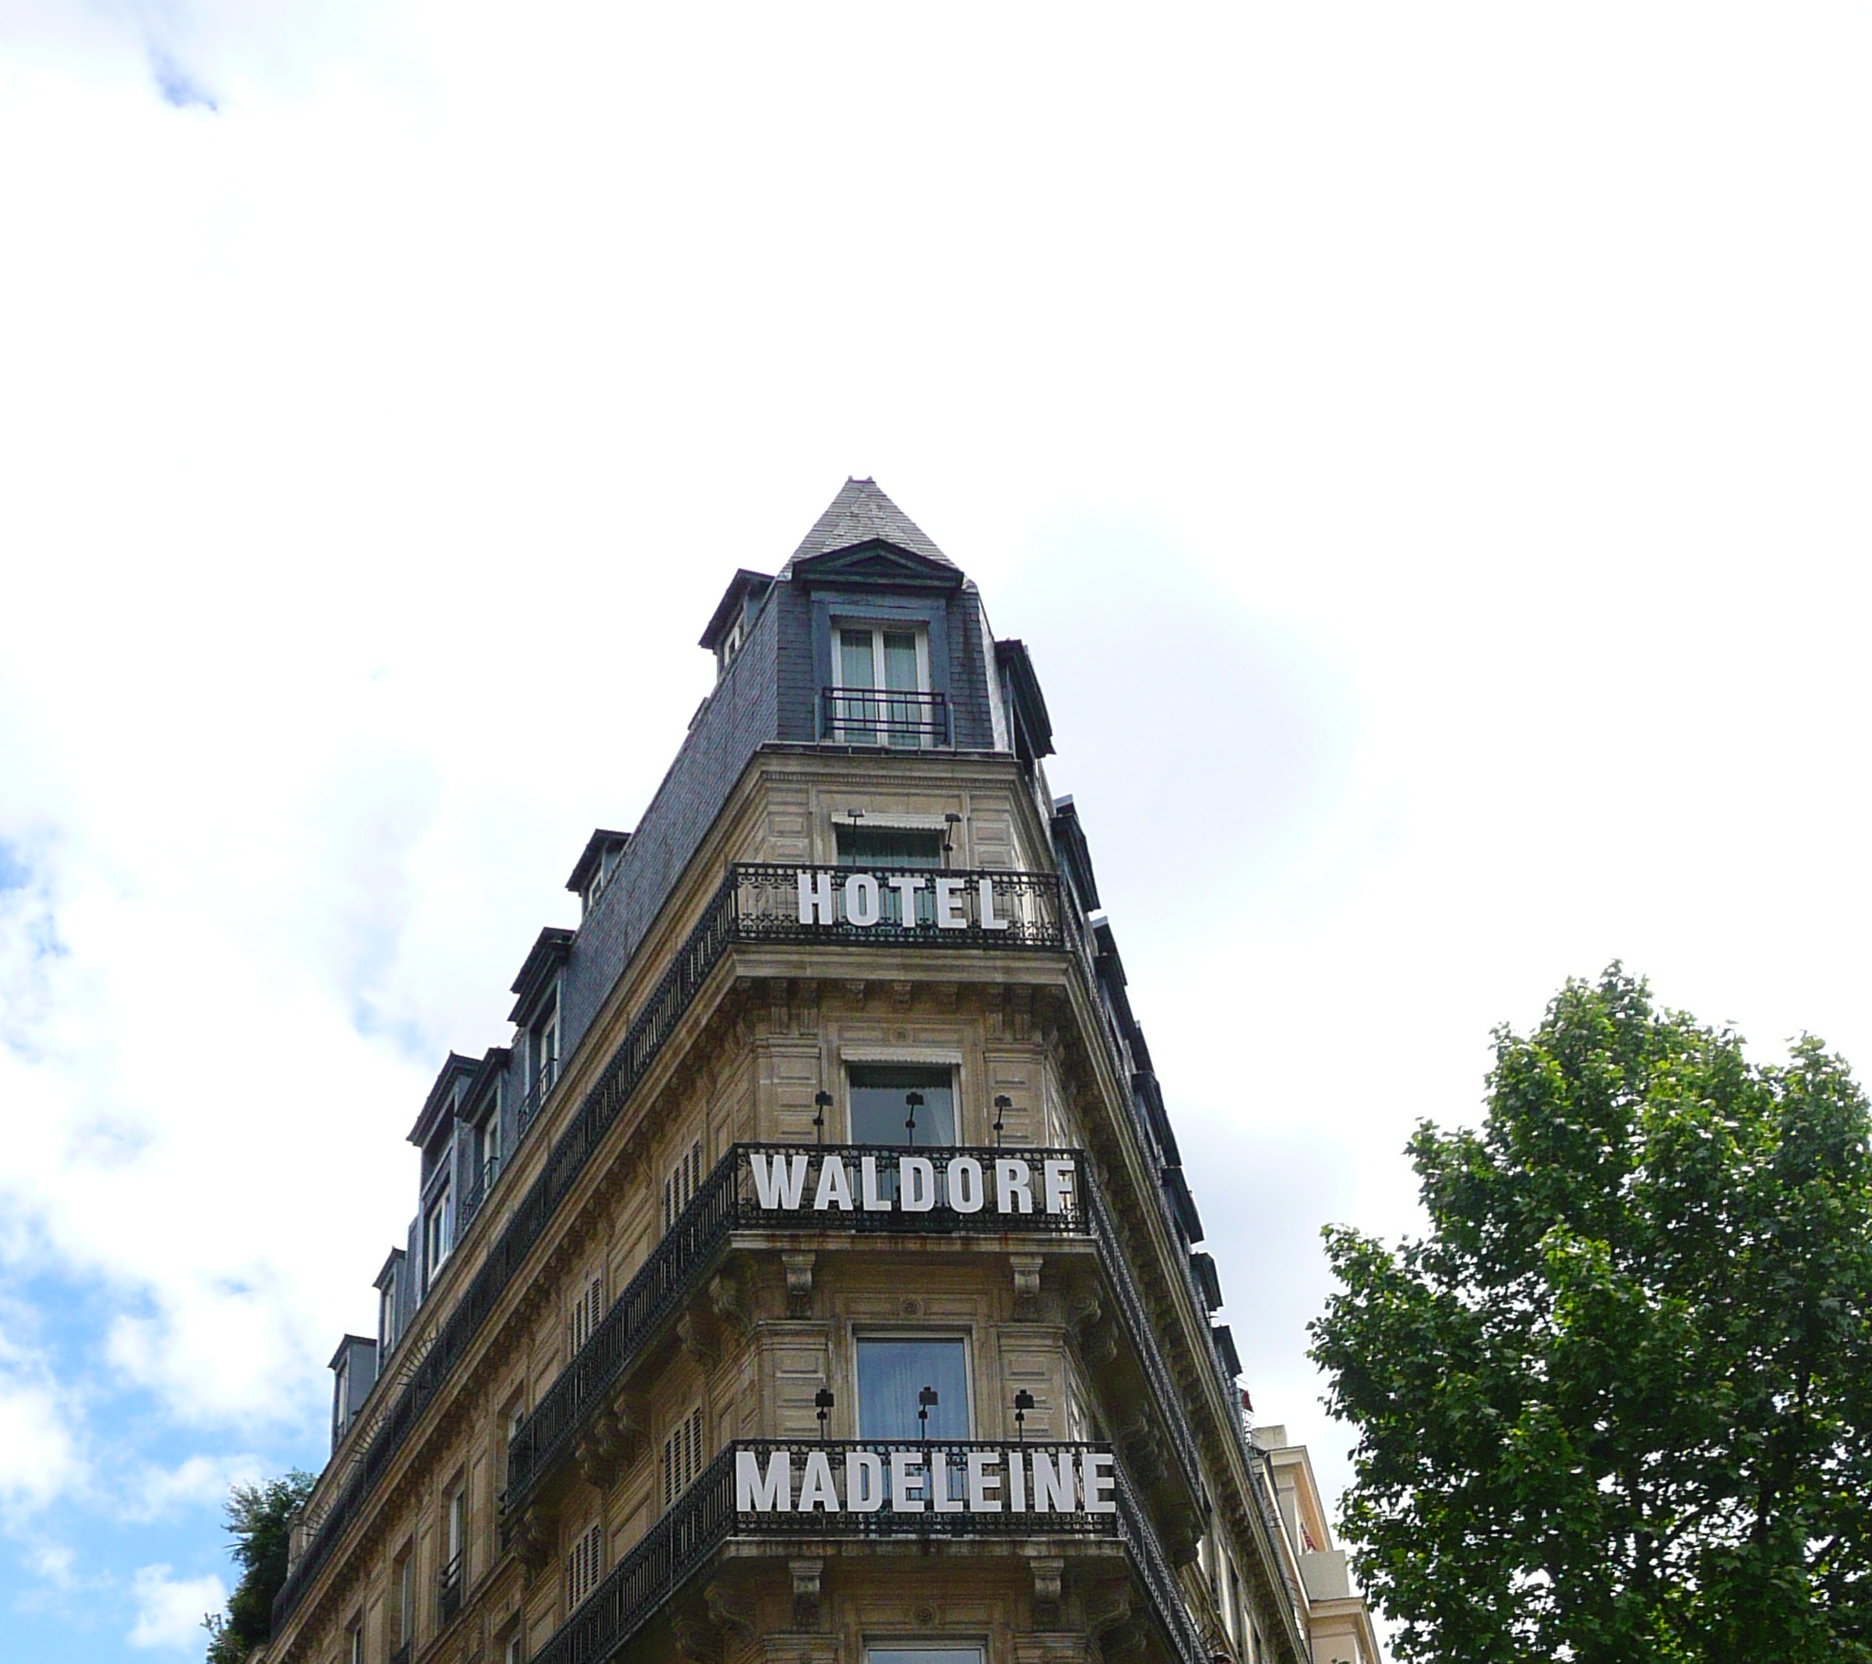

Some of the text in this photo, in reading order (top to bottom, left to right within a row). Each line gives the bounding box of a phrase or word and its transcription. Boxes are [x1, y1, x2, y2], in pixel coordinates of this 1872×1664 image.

[797, 873, 1008, 930] HOTEL
[750, 1153, 1076, 1214] WALDORF
[735, 1450, 1117, 1513] MADELEINE
